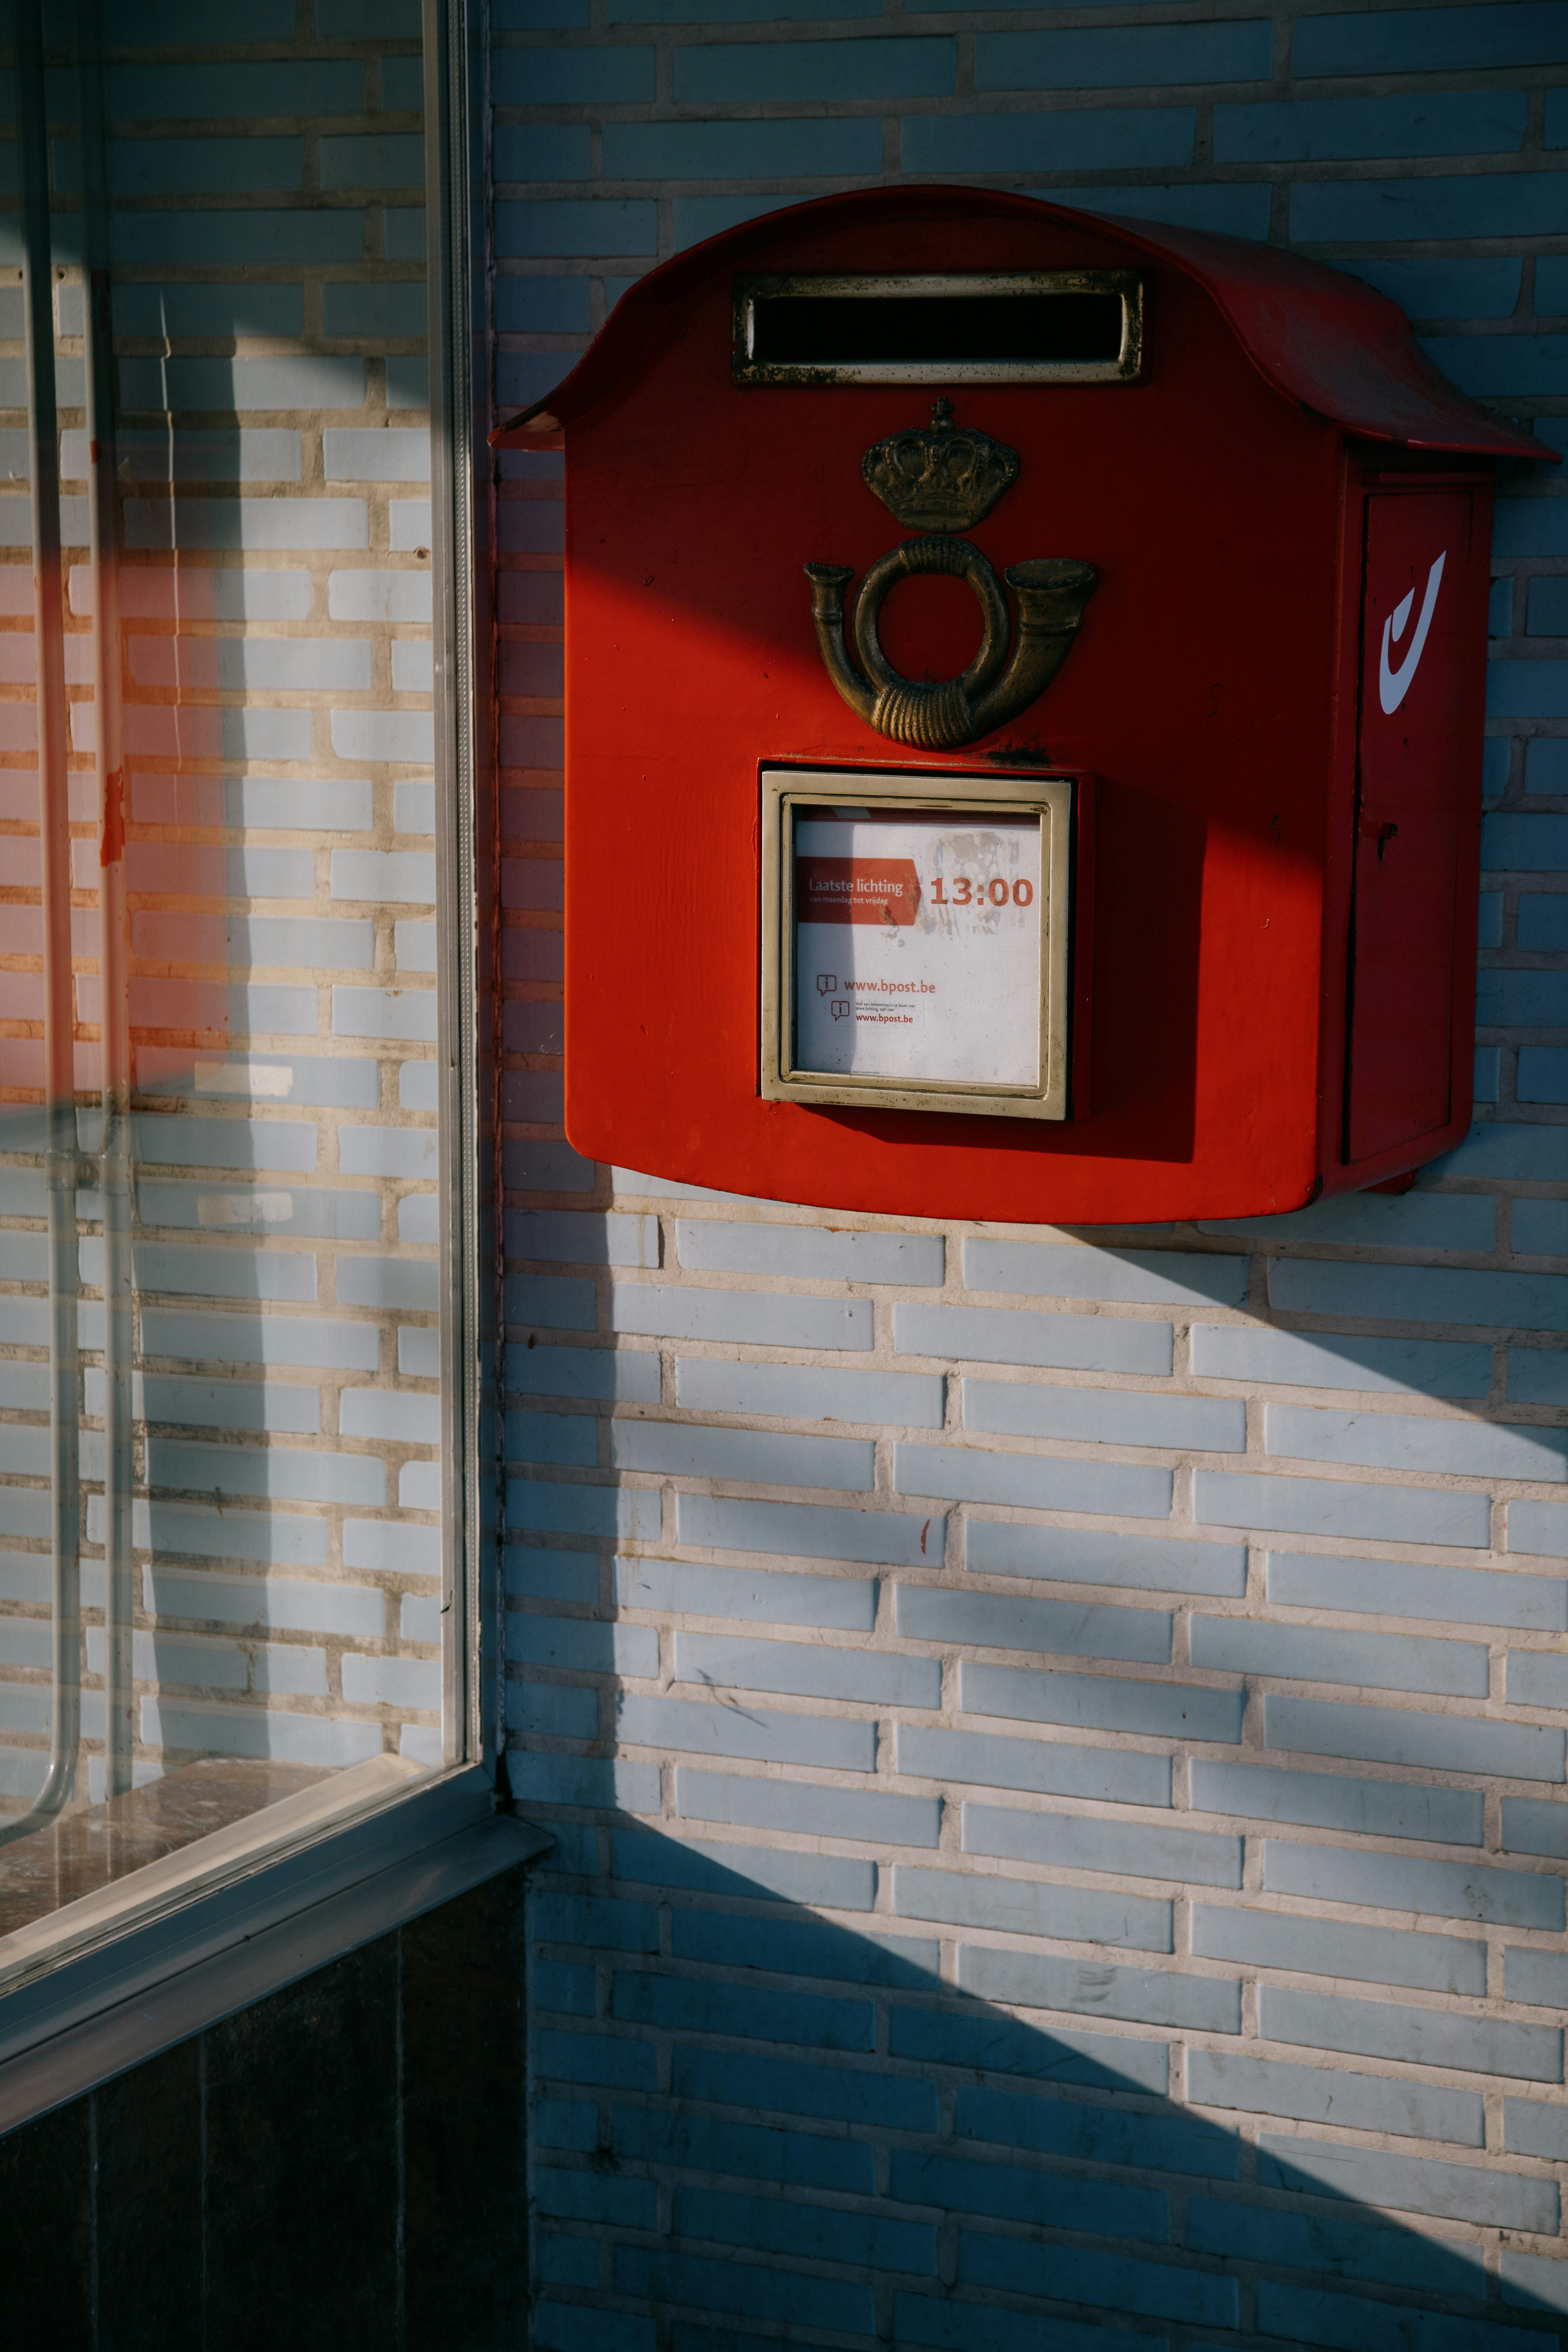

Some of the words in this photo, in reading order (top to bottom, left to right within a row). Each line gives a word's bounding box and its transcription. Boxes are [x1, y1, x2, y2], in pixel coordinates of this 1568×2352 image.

[809, 879, 853, 892] Laatste
[857, 878, 903, 897] lichting
[931, 877, 1033, 907] 13:00
[823, 896, 852, 905] maandag
[865, 897, 888, 905] vrijdag
[844, 979, 936, 995] www.bpost.be
[856, 1014, 913, 1024] www.bpost.be
